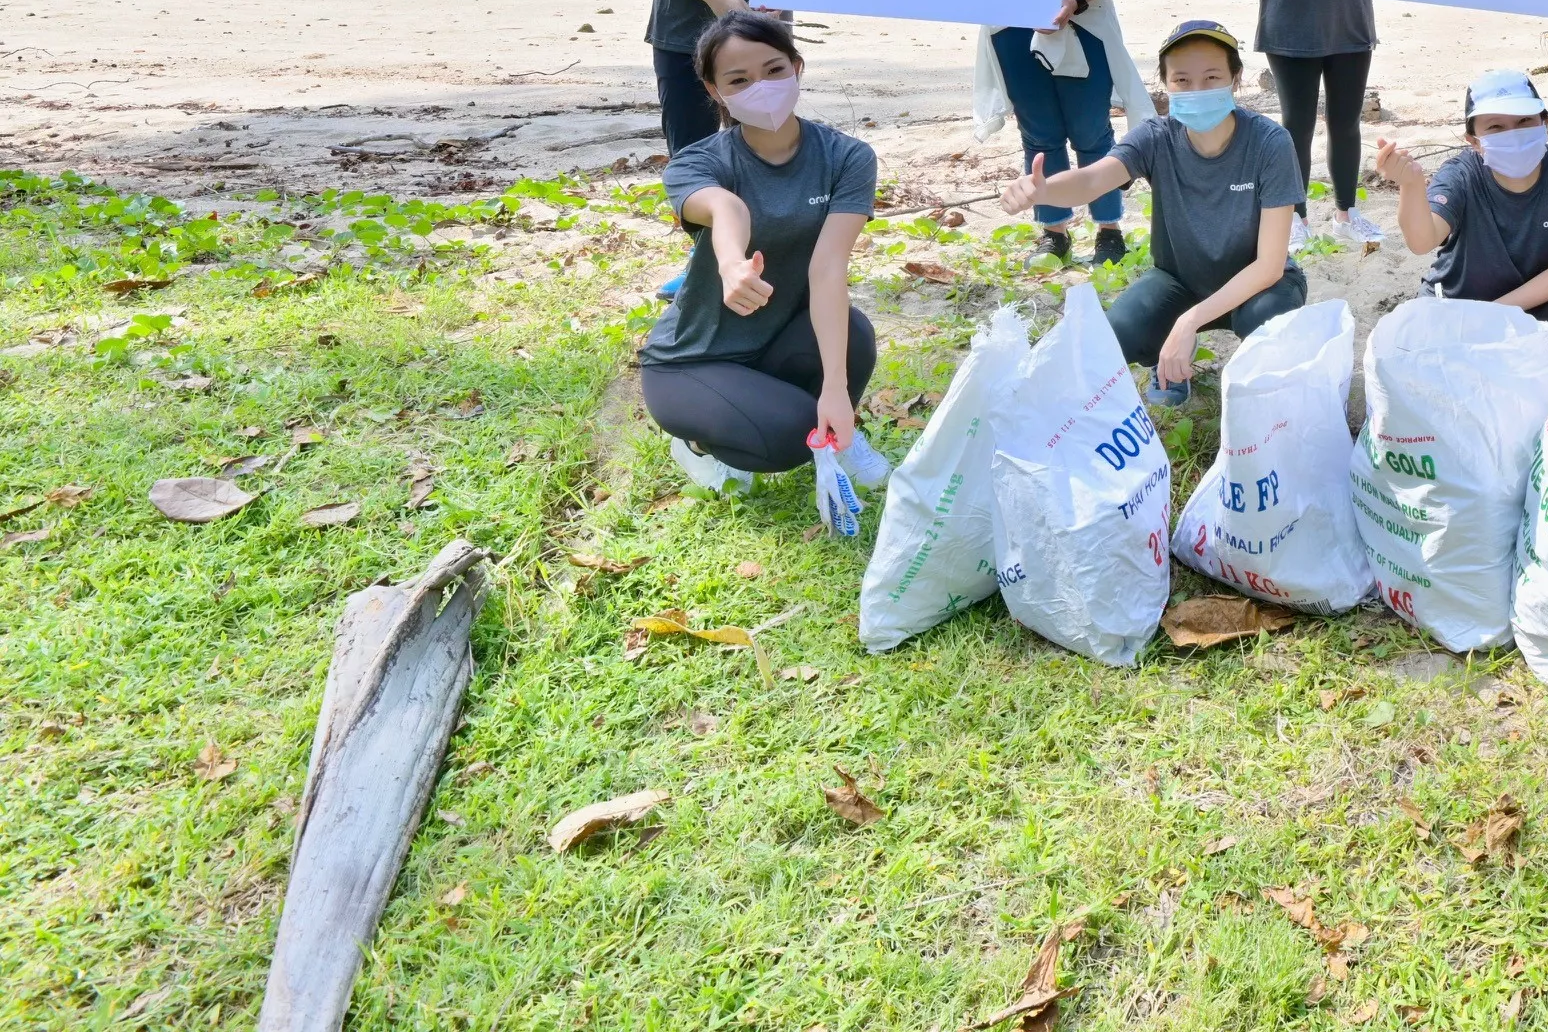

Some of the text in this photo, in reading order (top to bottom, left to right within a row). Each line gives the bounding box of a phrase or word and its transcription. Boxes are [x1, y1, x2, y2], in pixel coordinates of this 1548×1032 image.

[1083, 394, 1101, 411] RICE
[1094, 405, 1155, 471] DOUB
[1237, 443, 1258, 456] THAI
[1396, 435, 1436, 444] FAIRPRICE
[1385, 450, 1437, 481] GOLD
[1117, 463, 1168, 520] THAI HOM
[1256, 469, 1279, 512] FP
[1361, 478, 1379, 500] HOM
[1401, 503, 1428, 521] RICE
[1226, 532, 1263, 555] MALI
[1386, 519, 1427, 546] QUALITY
[888, 542, 933, 604] Jasmine
[924, 529, 939, 541] 2
[1376, 553, 1432, 589] OF THAILAND
